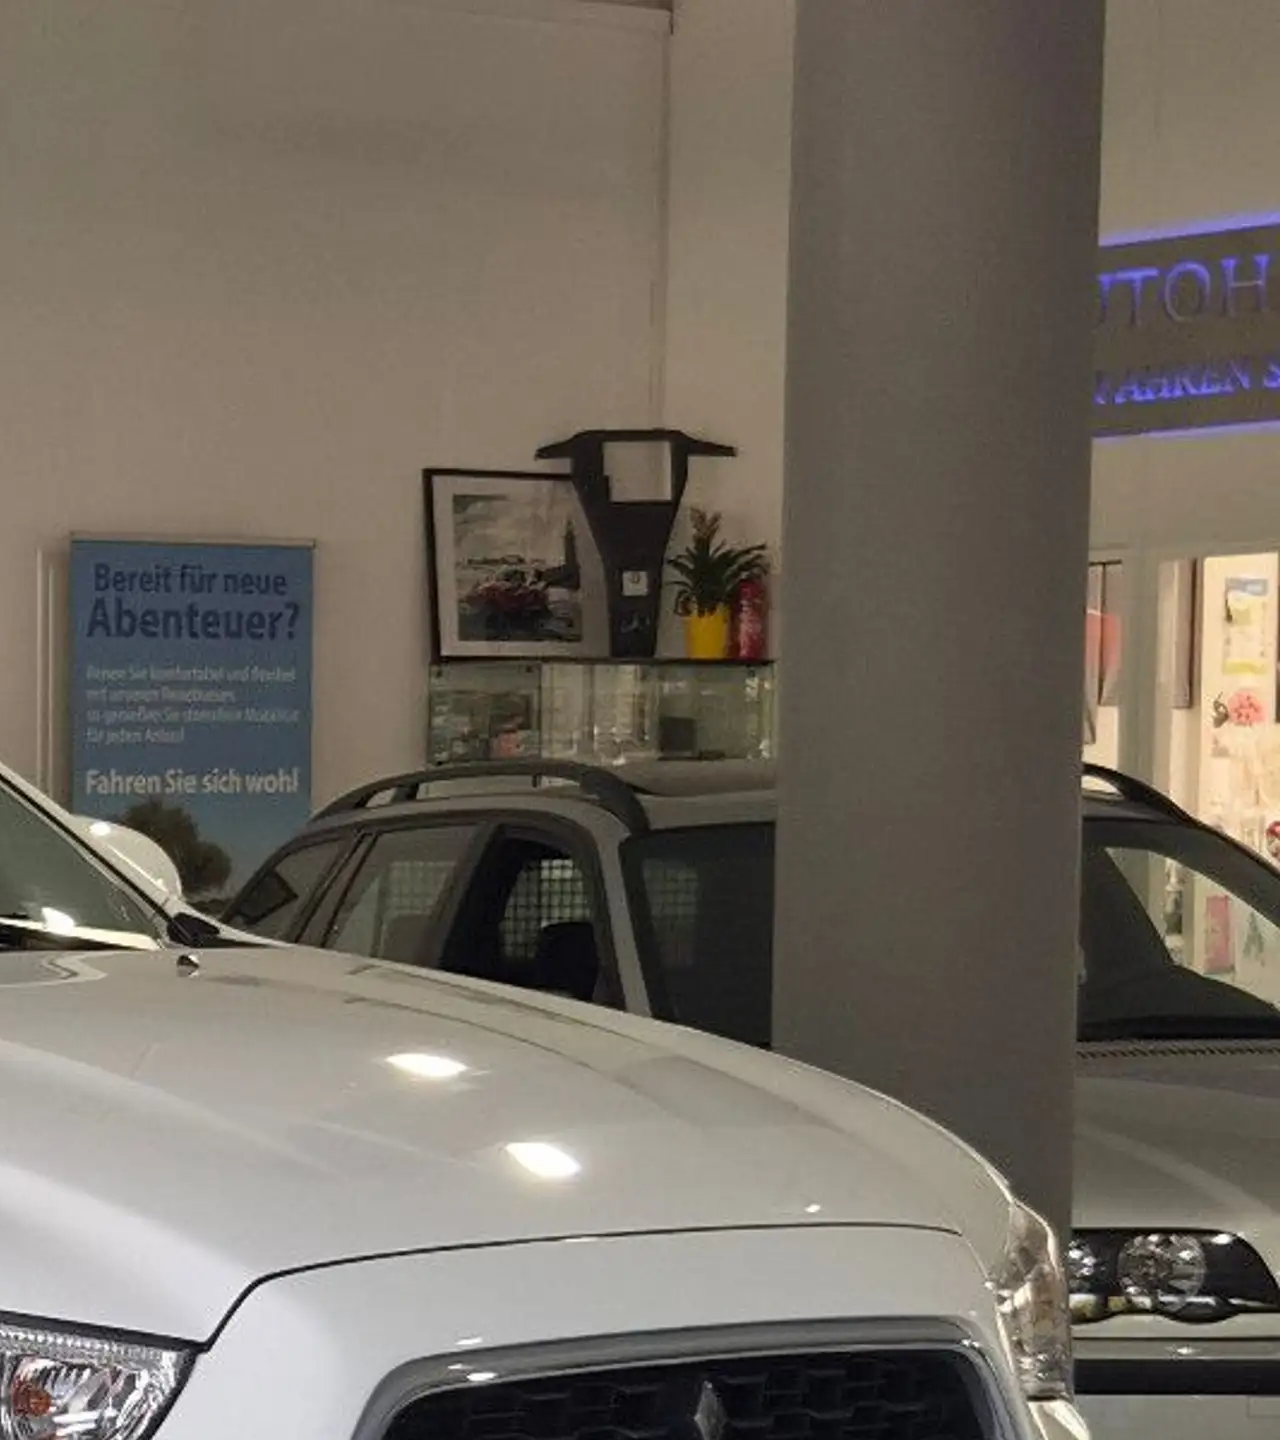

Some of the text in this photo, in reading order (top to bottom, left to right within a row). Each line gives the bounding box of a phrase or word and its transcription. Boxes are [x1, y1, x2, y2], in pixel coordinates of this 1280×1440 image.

[94, 563, 288, 596] Bereit für neue
[86, 597, 300, 641] Abenteuer?
[85, 767, 298, 794] Fahren Sie sich wohl
